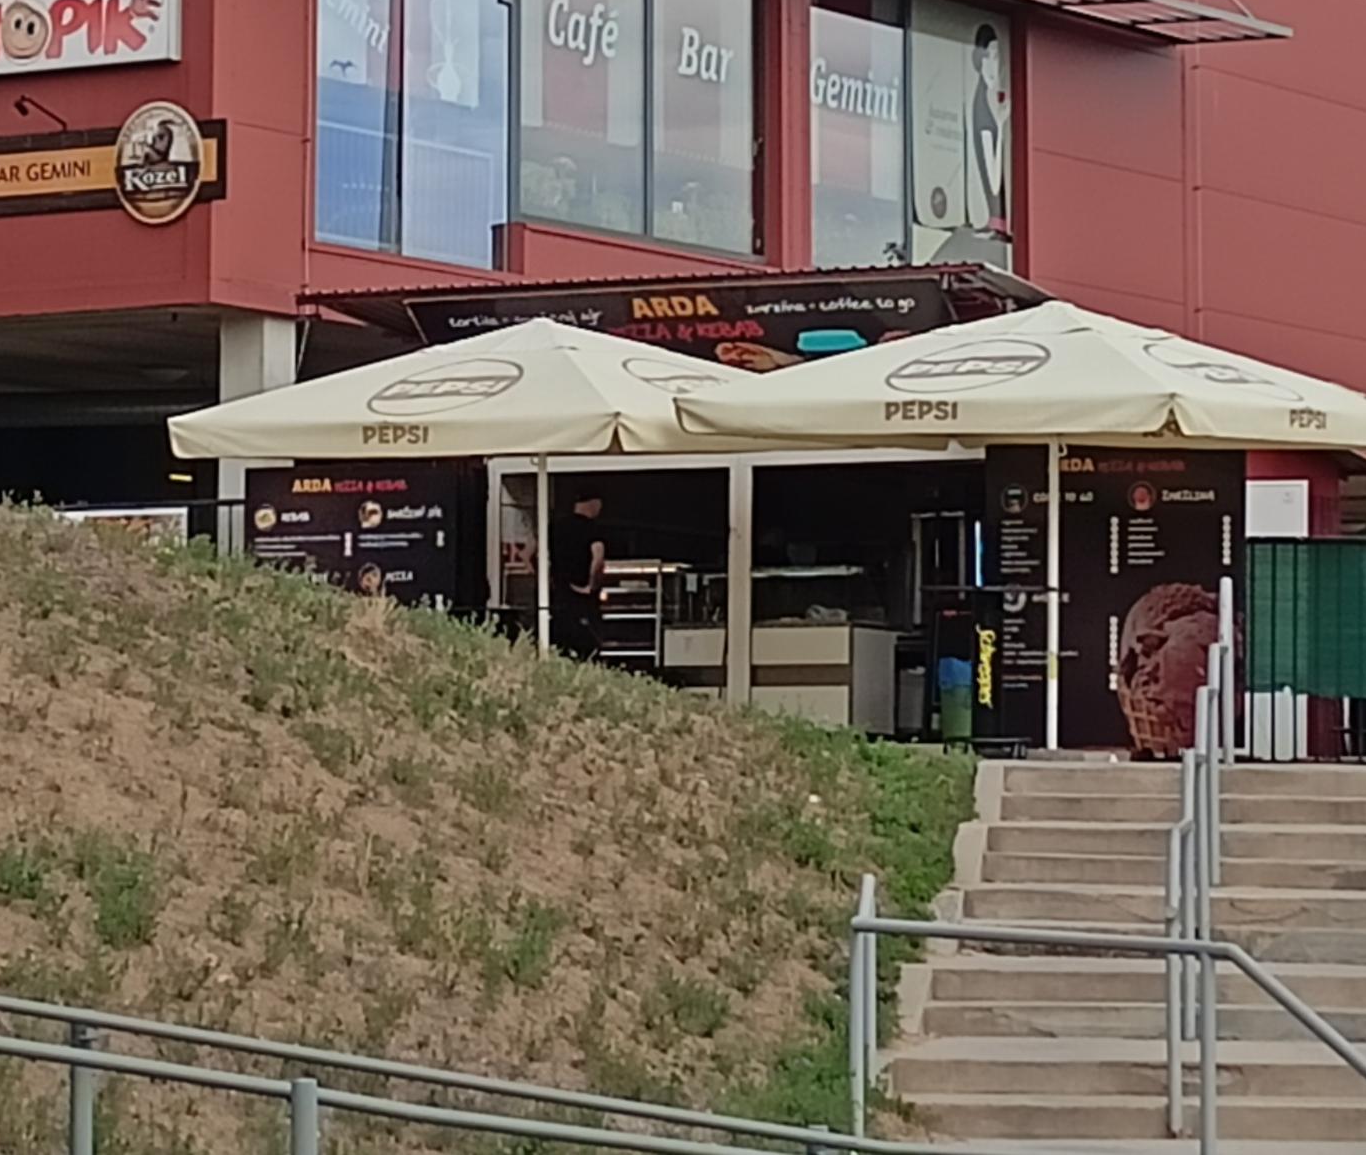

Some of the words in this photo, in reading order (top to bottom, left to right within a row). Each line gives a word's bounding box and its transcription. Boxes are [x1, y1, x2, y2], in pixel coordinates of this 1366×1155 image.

[678, 27, 735, 84] Bar
[810, 57, 899, 123] Gemini
[25, 160, 91, 183] GEMINI
[123, 165, 187, 191] Kozel
[631, 295, 720, 319] ARDA
[876, 297, 895, 309] to
[898, 298, 915, 313] go
[381, 379, 503, 397] PEPSI
[885, 400, 958, 421] PEPSI
[1289, 407, 1328, 429] PEPSI
[362, 425, 429, 445] PEPSI
[292, 478, 332, 494] ARDA
